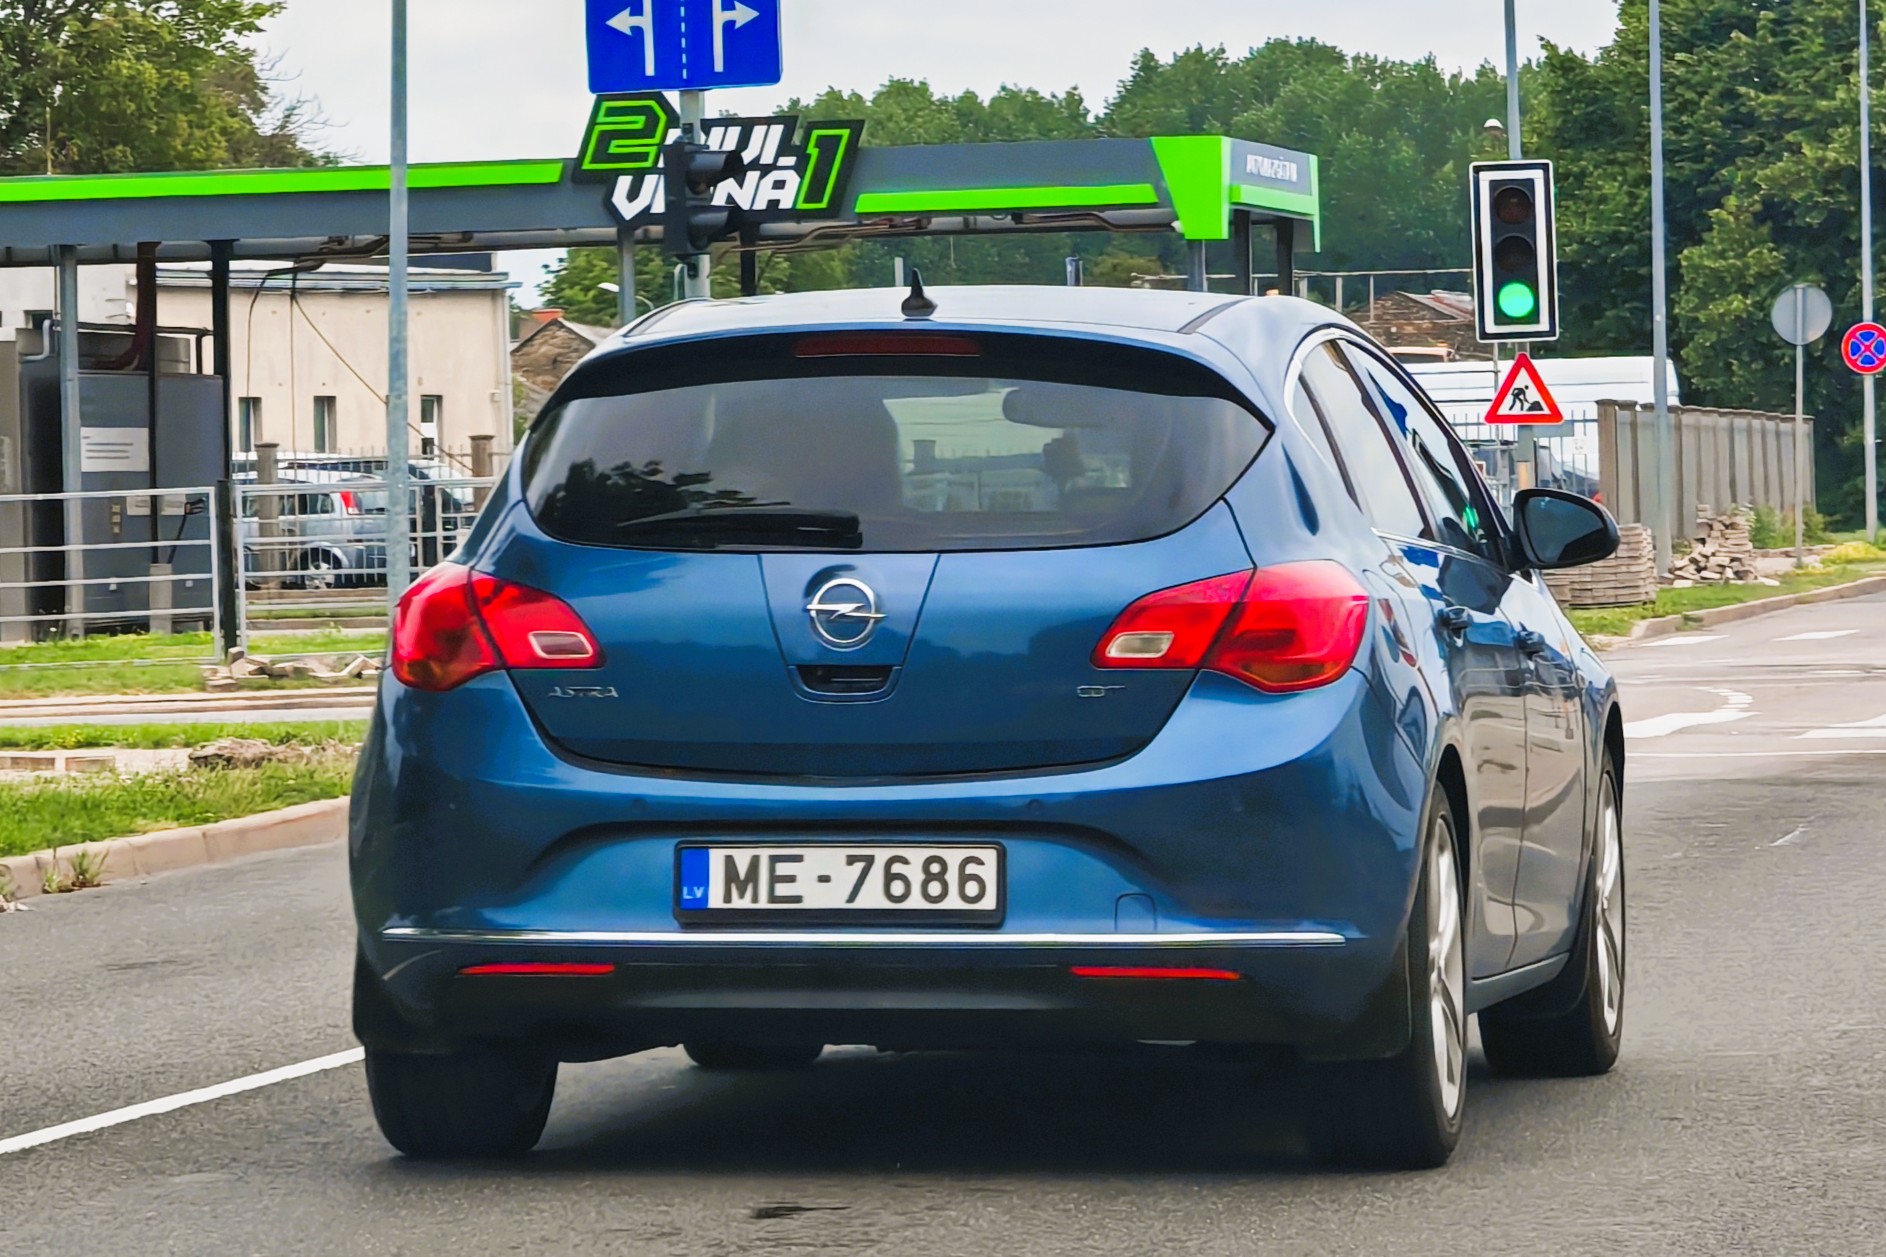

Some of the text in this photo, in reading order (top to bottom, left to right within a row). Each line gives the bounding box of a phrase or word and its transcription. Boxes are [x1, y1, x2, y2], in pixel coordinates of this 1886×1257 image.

[581, 100, 786, 170] 2 IVI
[611, 128, 851, 220] VINĀ 1
[683, 886, 705, 899] LV
[722, 854, 987, 904] ME-7686
